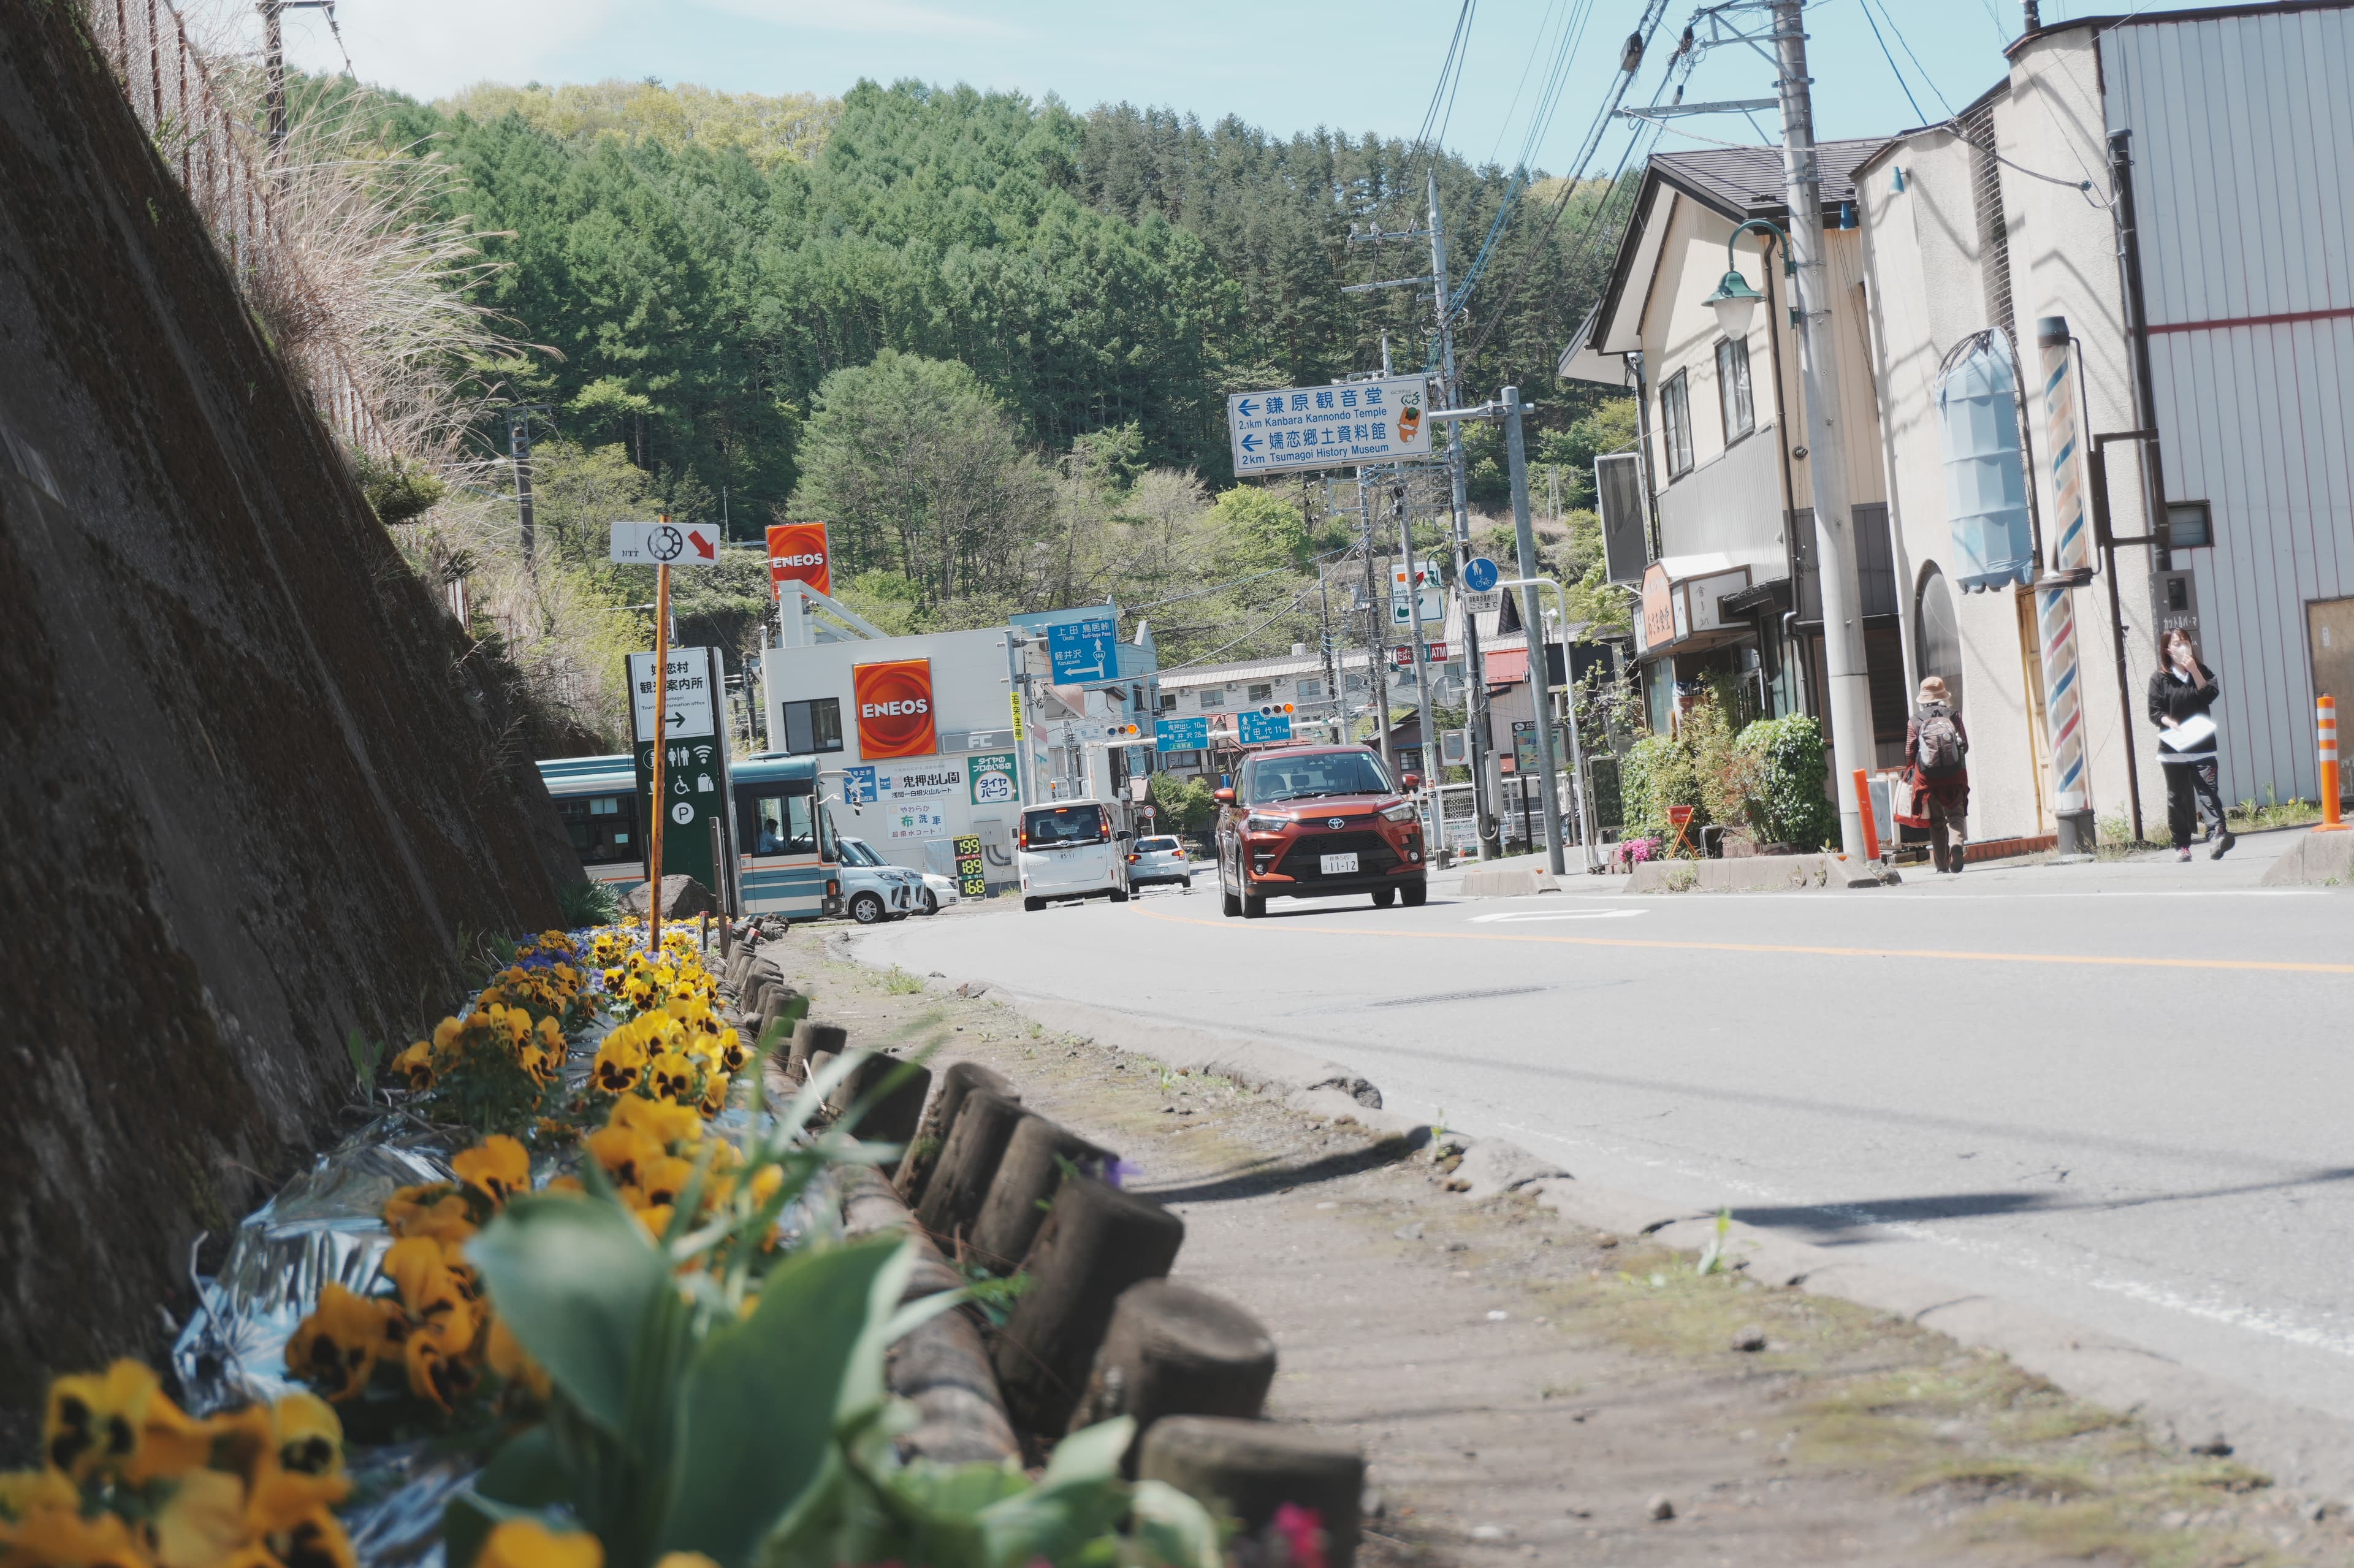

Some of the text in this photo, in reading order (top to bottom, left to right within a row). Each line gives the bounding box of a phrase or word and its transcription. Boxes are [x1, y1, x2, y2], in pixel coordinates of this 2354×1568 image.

[1266, 387, 1382, 414] 鎌原観音堂
[1239, 407, 1387, 430] 2.1km Kanbara Kannondo Temple
[1269, 422, 1386, 450] 嬬恋郷土資料館
[1270, 449, 1313, 462] Tsumagoi
[1317, 447, 1347, 458] History
[1351, 444, 1388, 455] Museum
[772, 553, 823, 568] ENEOS
[1057, 622, 1110, 636] 上田 鳥居峠
[1055, 649, 1083, 661] 軽井沢
[1431, 647, 1447, 658] ATM
[862, 698, 928, 718] ENEOS
[1012, 695, 1024, 738] 追突注意
[1253, 726, 1273, 736] 田代
[968, 734, 992, 748] FC
[973, 763, 1011, 772] プロのいる店
[978, 756, 1005, 765] タイヤの
[904, 772, 959, 788] 鬼押出し園
[980, 778, 1007, 788] タイヤ
[981, 787, 1007, 797] パーク
[959, 839, 980, 854] 199
[962, 859, 983, 874] 189
[1331, 861, 1356, 872] 11-12
[964, 879, 986, 894] 168
